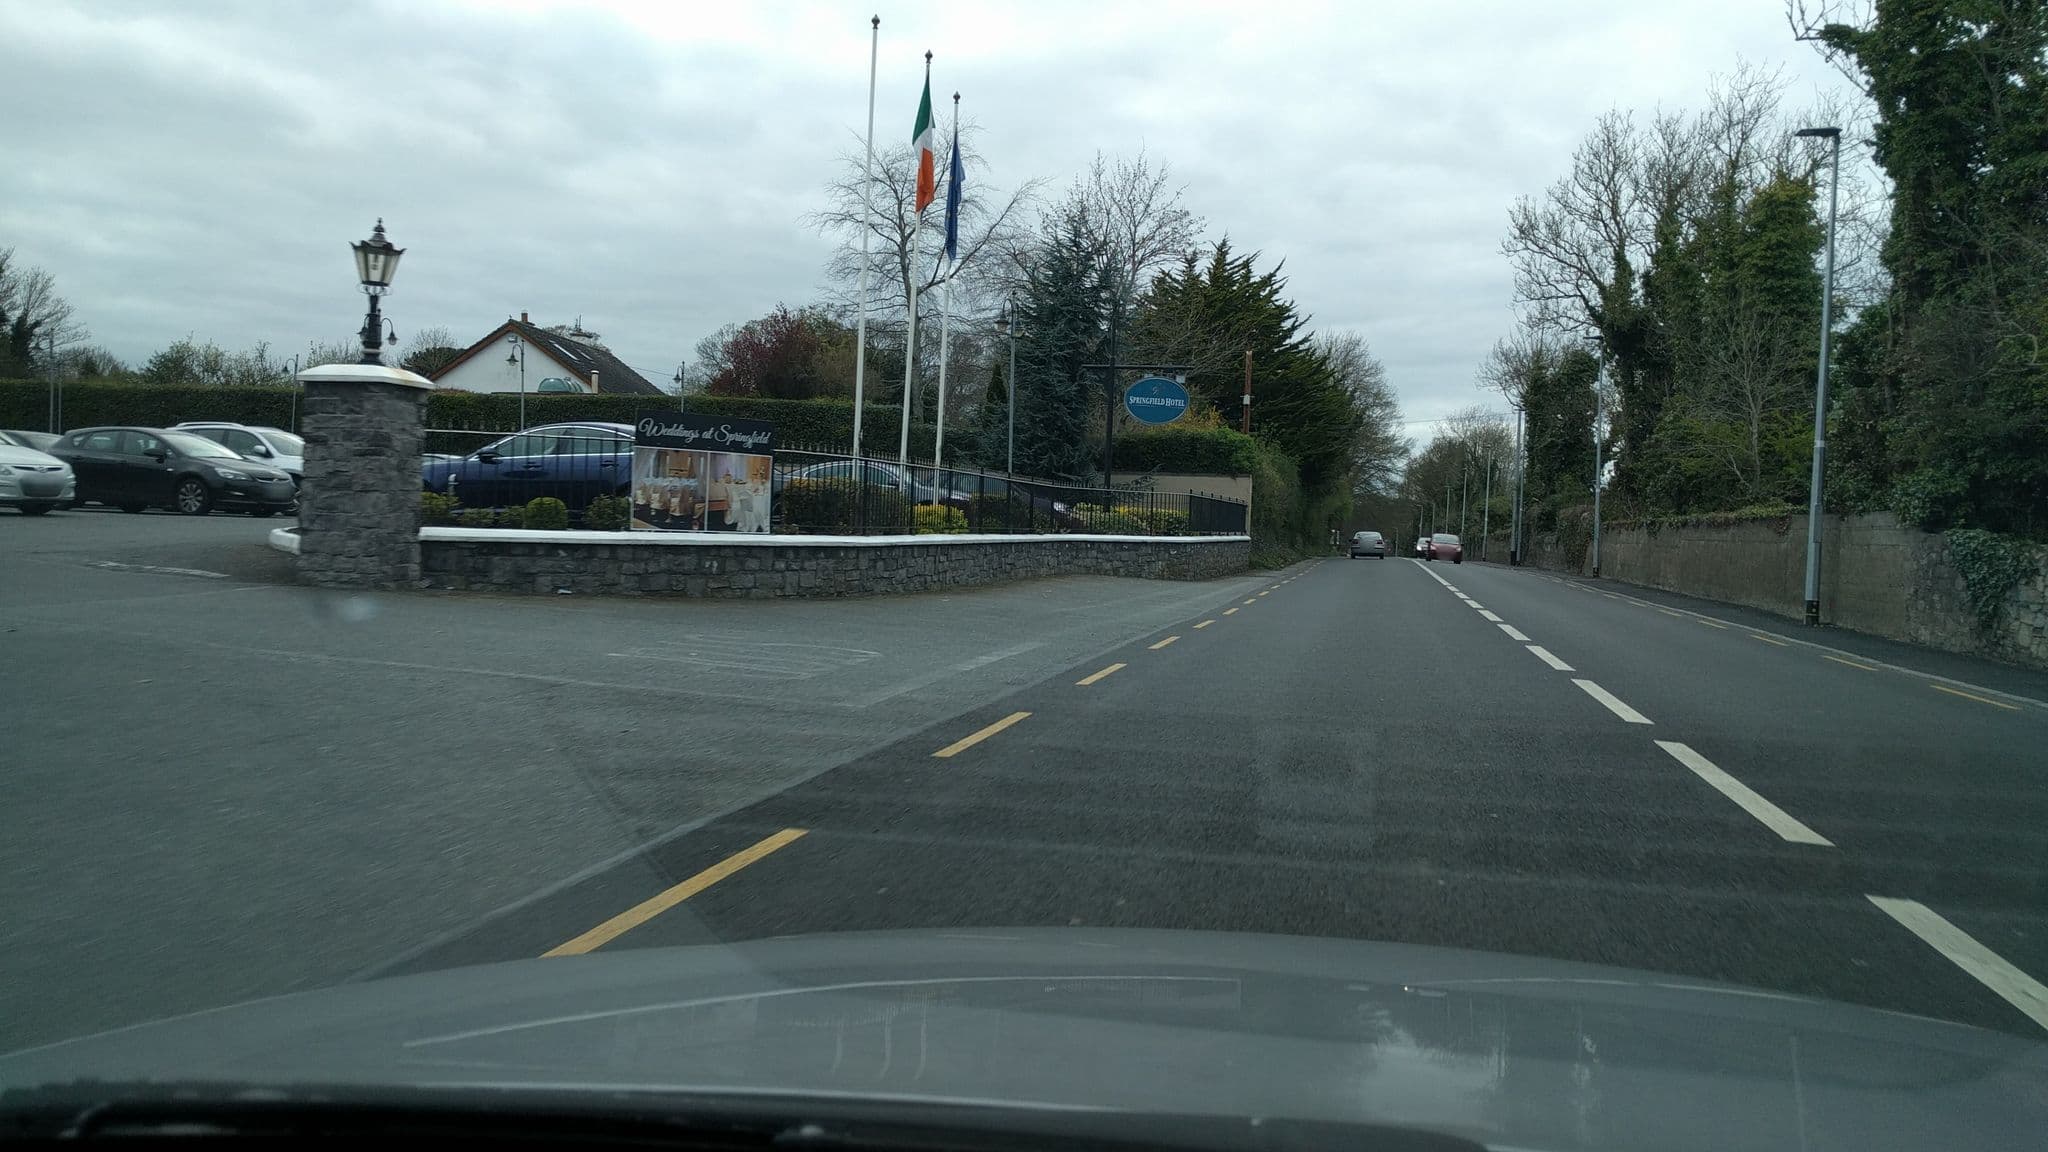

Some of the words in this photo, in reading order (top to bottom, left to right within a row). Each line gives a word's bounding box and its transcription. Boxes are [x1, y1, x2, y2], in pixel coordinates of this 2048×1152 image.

[1129, 395, 1165, 406] SPRINGFIELD
[1165, 397, 1185, 407] HOTEL
[638, 417, 700, 443] Weddings
[702, 427, 713, 439] at
[714, 424, 772, 448] Springfield
